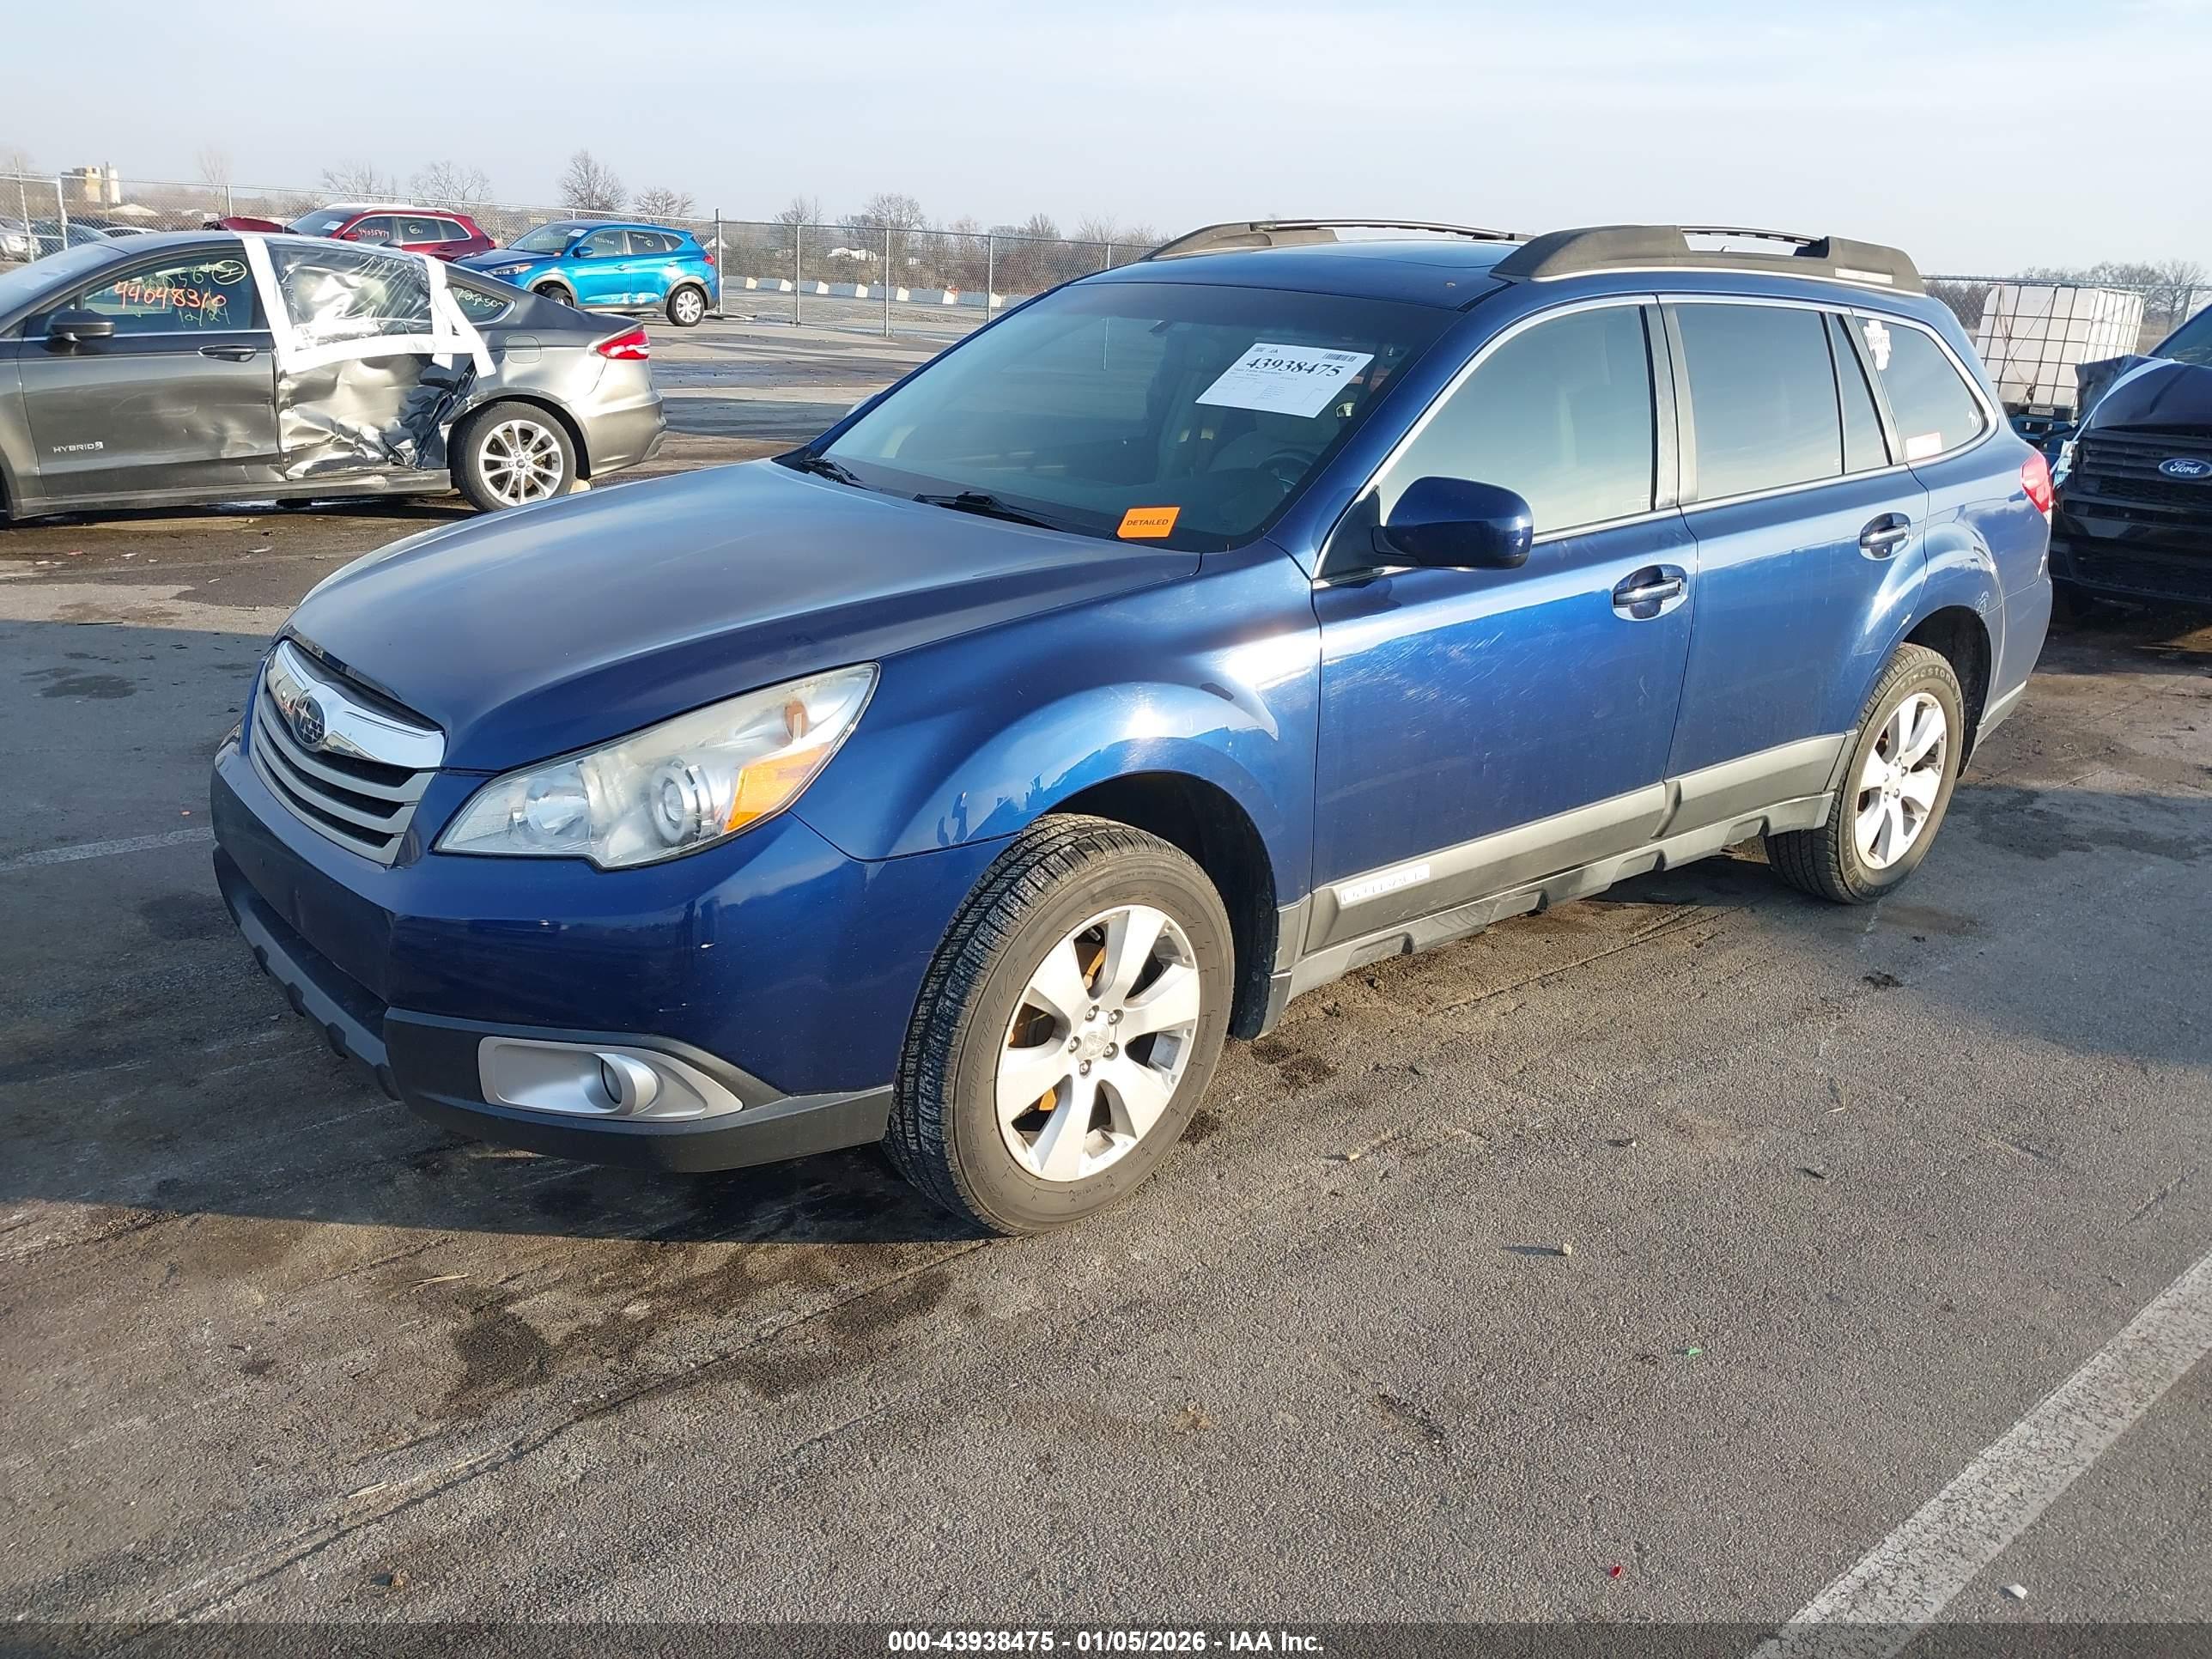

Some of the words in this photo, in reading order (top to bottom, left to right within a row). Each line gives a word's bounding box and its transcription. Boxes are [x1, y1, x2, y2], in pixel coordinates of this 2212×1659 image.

[1246, 357, 1346, 377] 43938475
[52, 443, 94, 453] HYBRID
[2169, 461, 2203, 474] Ford
